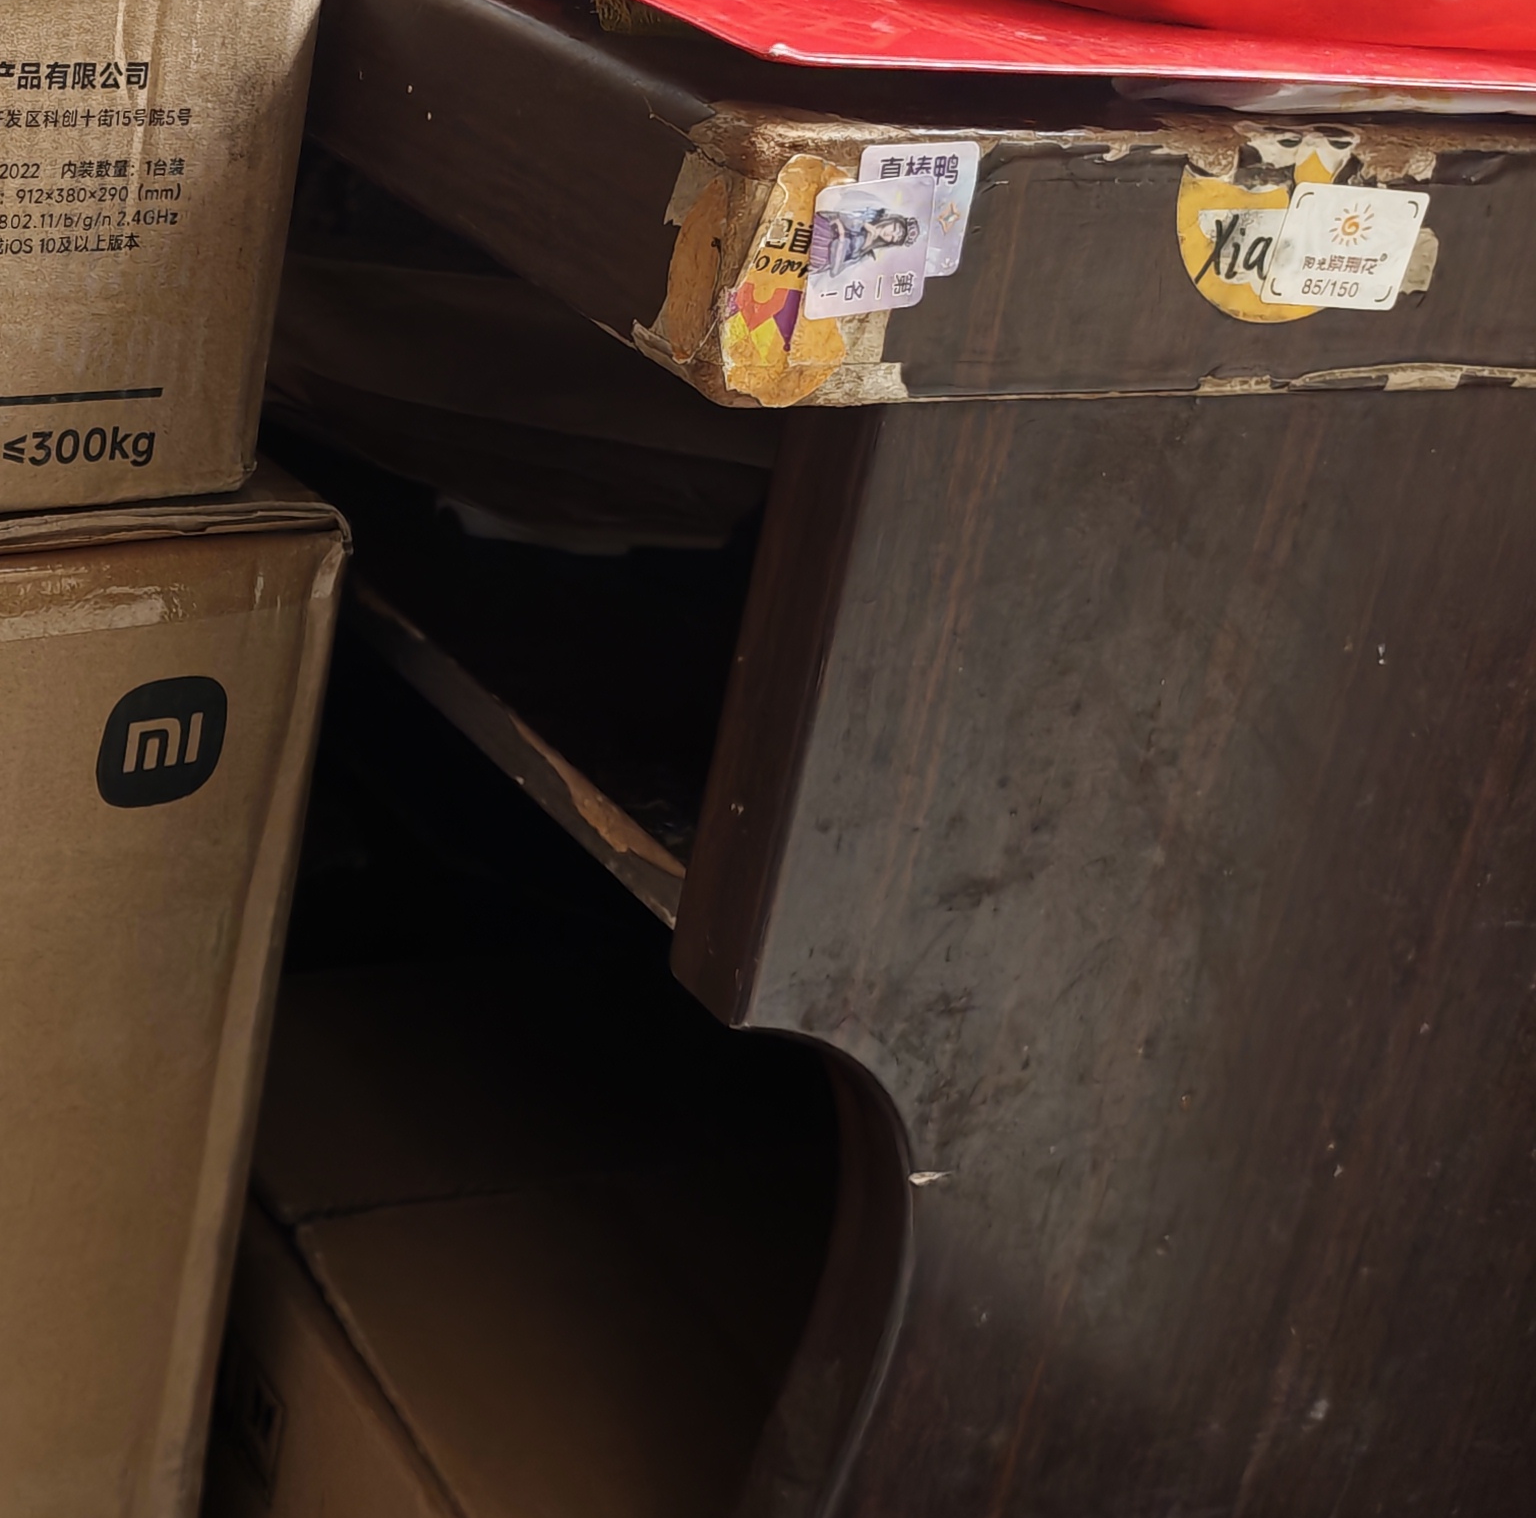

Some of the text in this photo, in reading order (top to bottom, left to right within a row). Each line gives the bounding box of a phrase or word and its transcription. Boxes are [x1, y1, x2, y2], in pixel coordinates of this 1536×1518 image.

[144, 156, 186, 178] 1台装
[116, 208, 180, 228] 2.4GHz
[39, 233, 141, 255] 10及以上版本
[1301, 278, 1360, 299] 85/150
